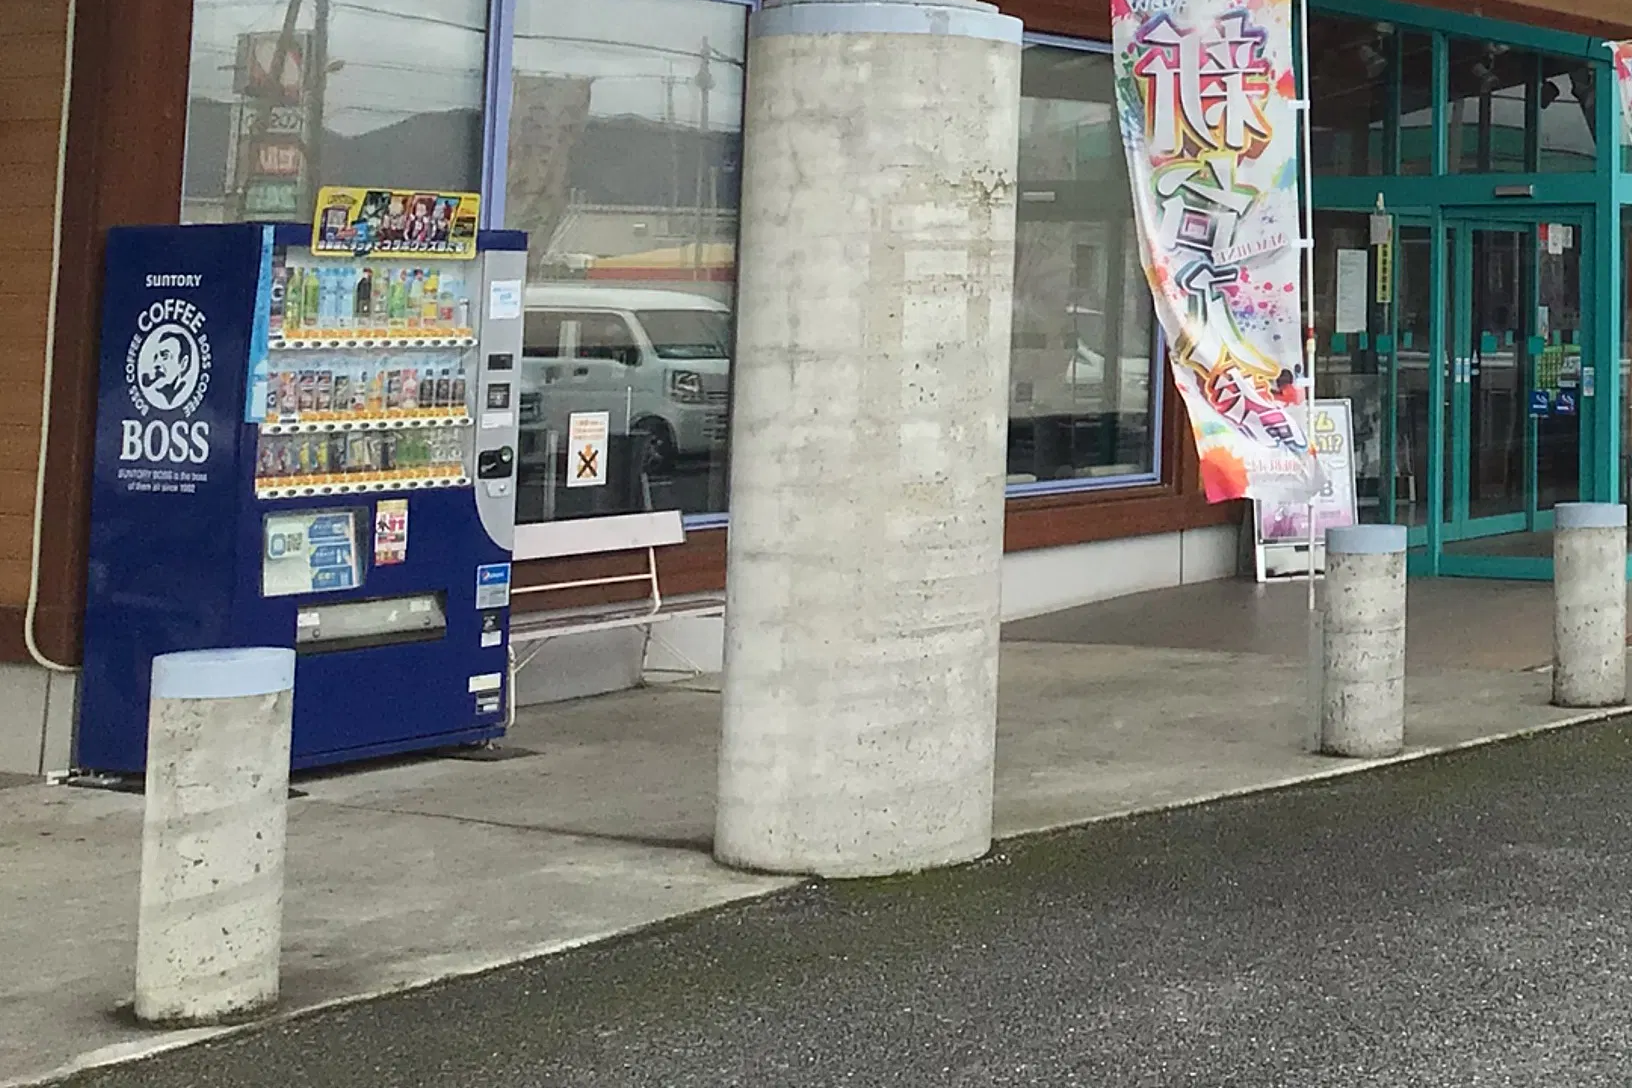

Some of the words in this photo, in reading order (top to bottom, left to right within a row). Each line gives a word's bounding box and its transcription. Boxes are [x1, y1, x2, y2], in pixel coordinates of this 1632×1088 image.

[145, 274, 203, 288] SUNTORY
[137, 298, 207, 334] COFFEE
[125, 333, 143, 384] COFFEE
[198, 333, 213, 369] BOSS
[119, 419, 210, 463] BOSS
